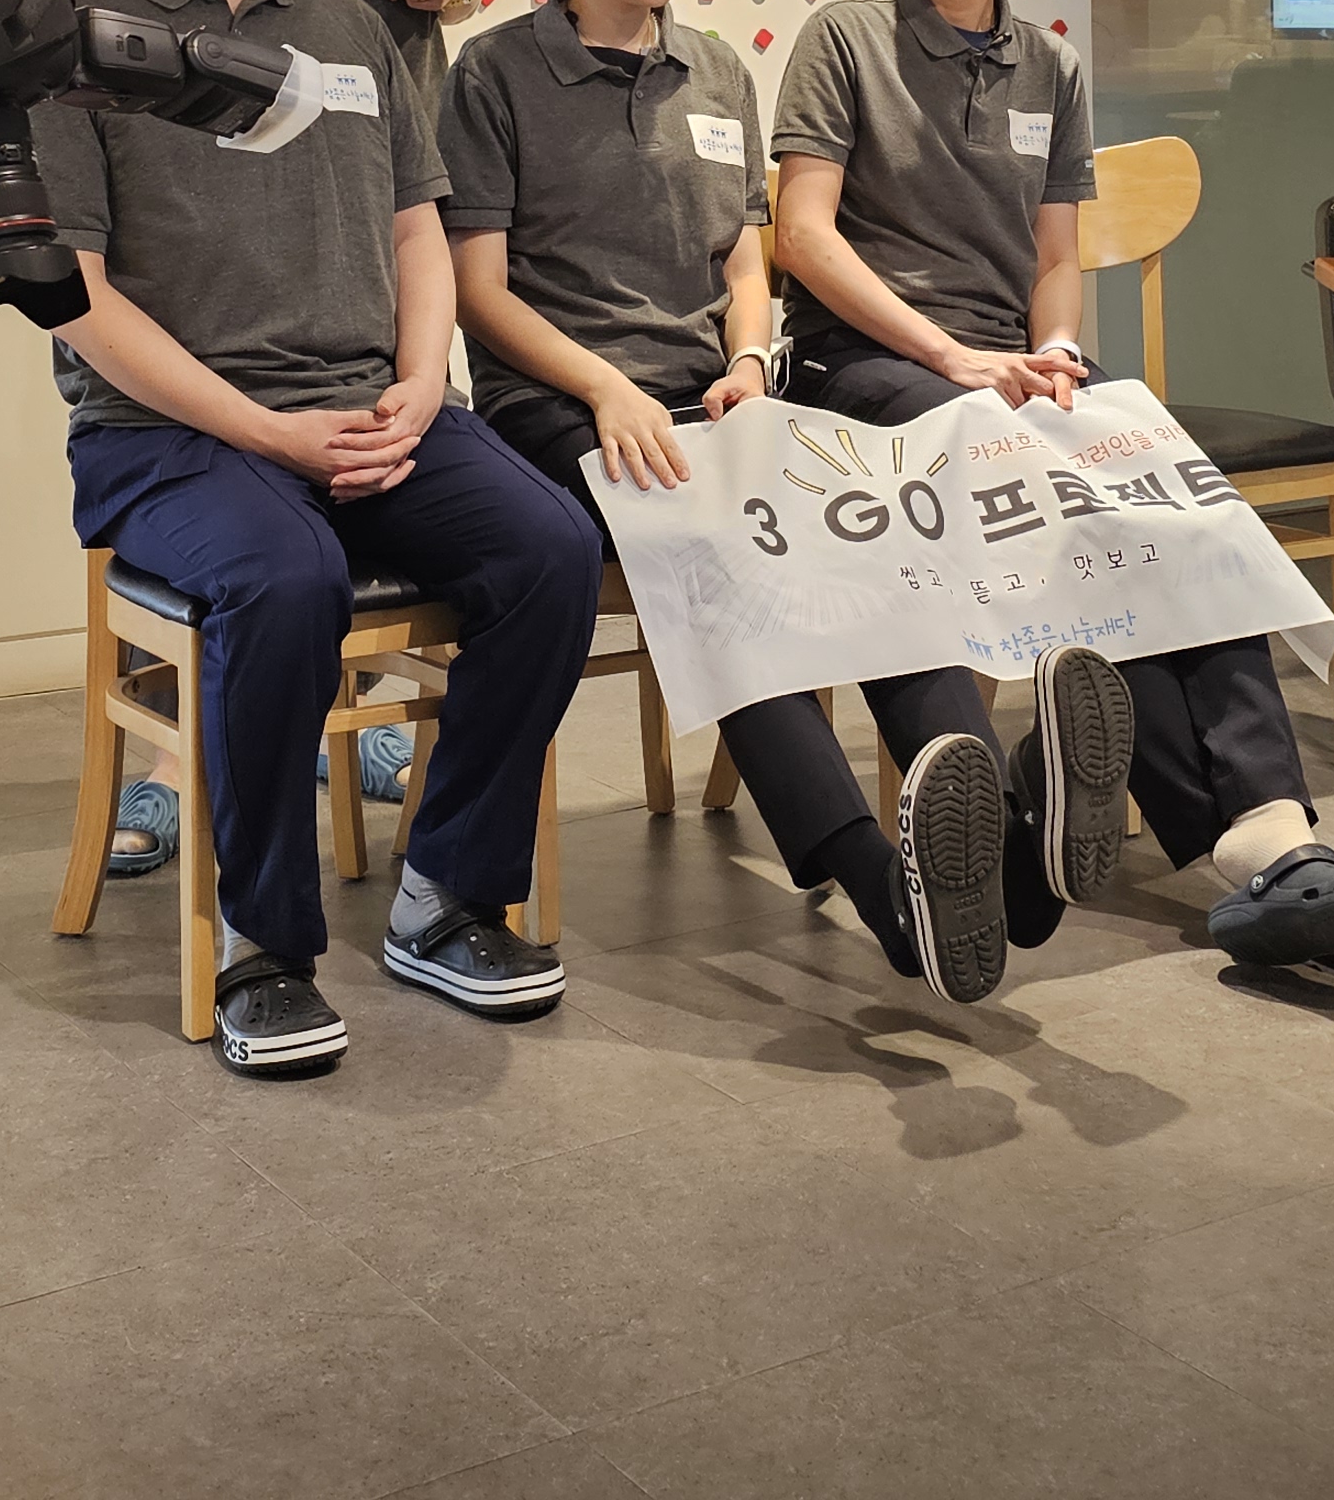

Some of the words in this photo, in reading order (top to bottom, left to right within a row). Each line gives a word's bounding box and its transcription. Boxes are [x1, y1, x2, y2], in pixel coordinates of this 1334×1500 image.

[1067, 430, 1155, 470] 고려인을
[744, 498, 788, 556] 3
[824, 480, 945, 542] GO
[970, 460, 1246, 544] 프로젝트
[1074, 543, 1161, 581] 맛보고
[897, 793, 922, 896] crocs
